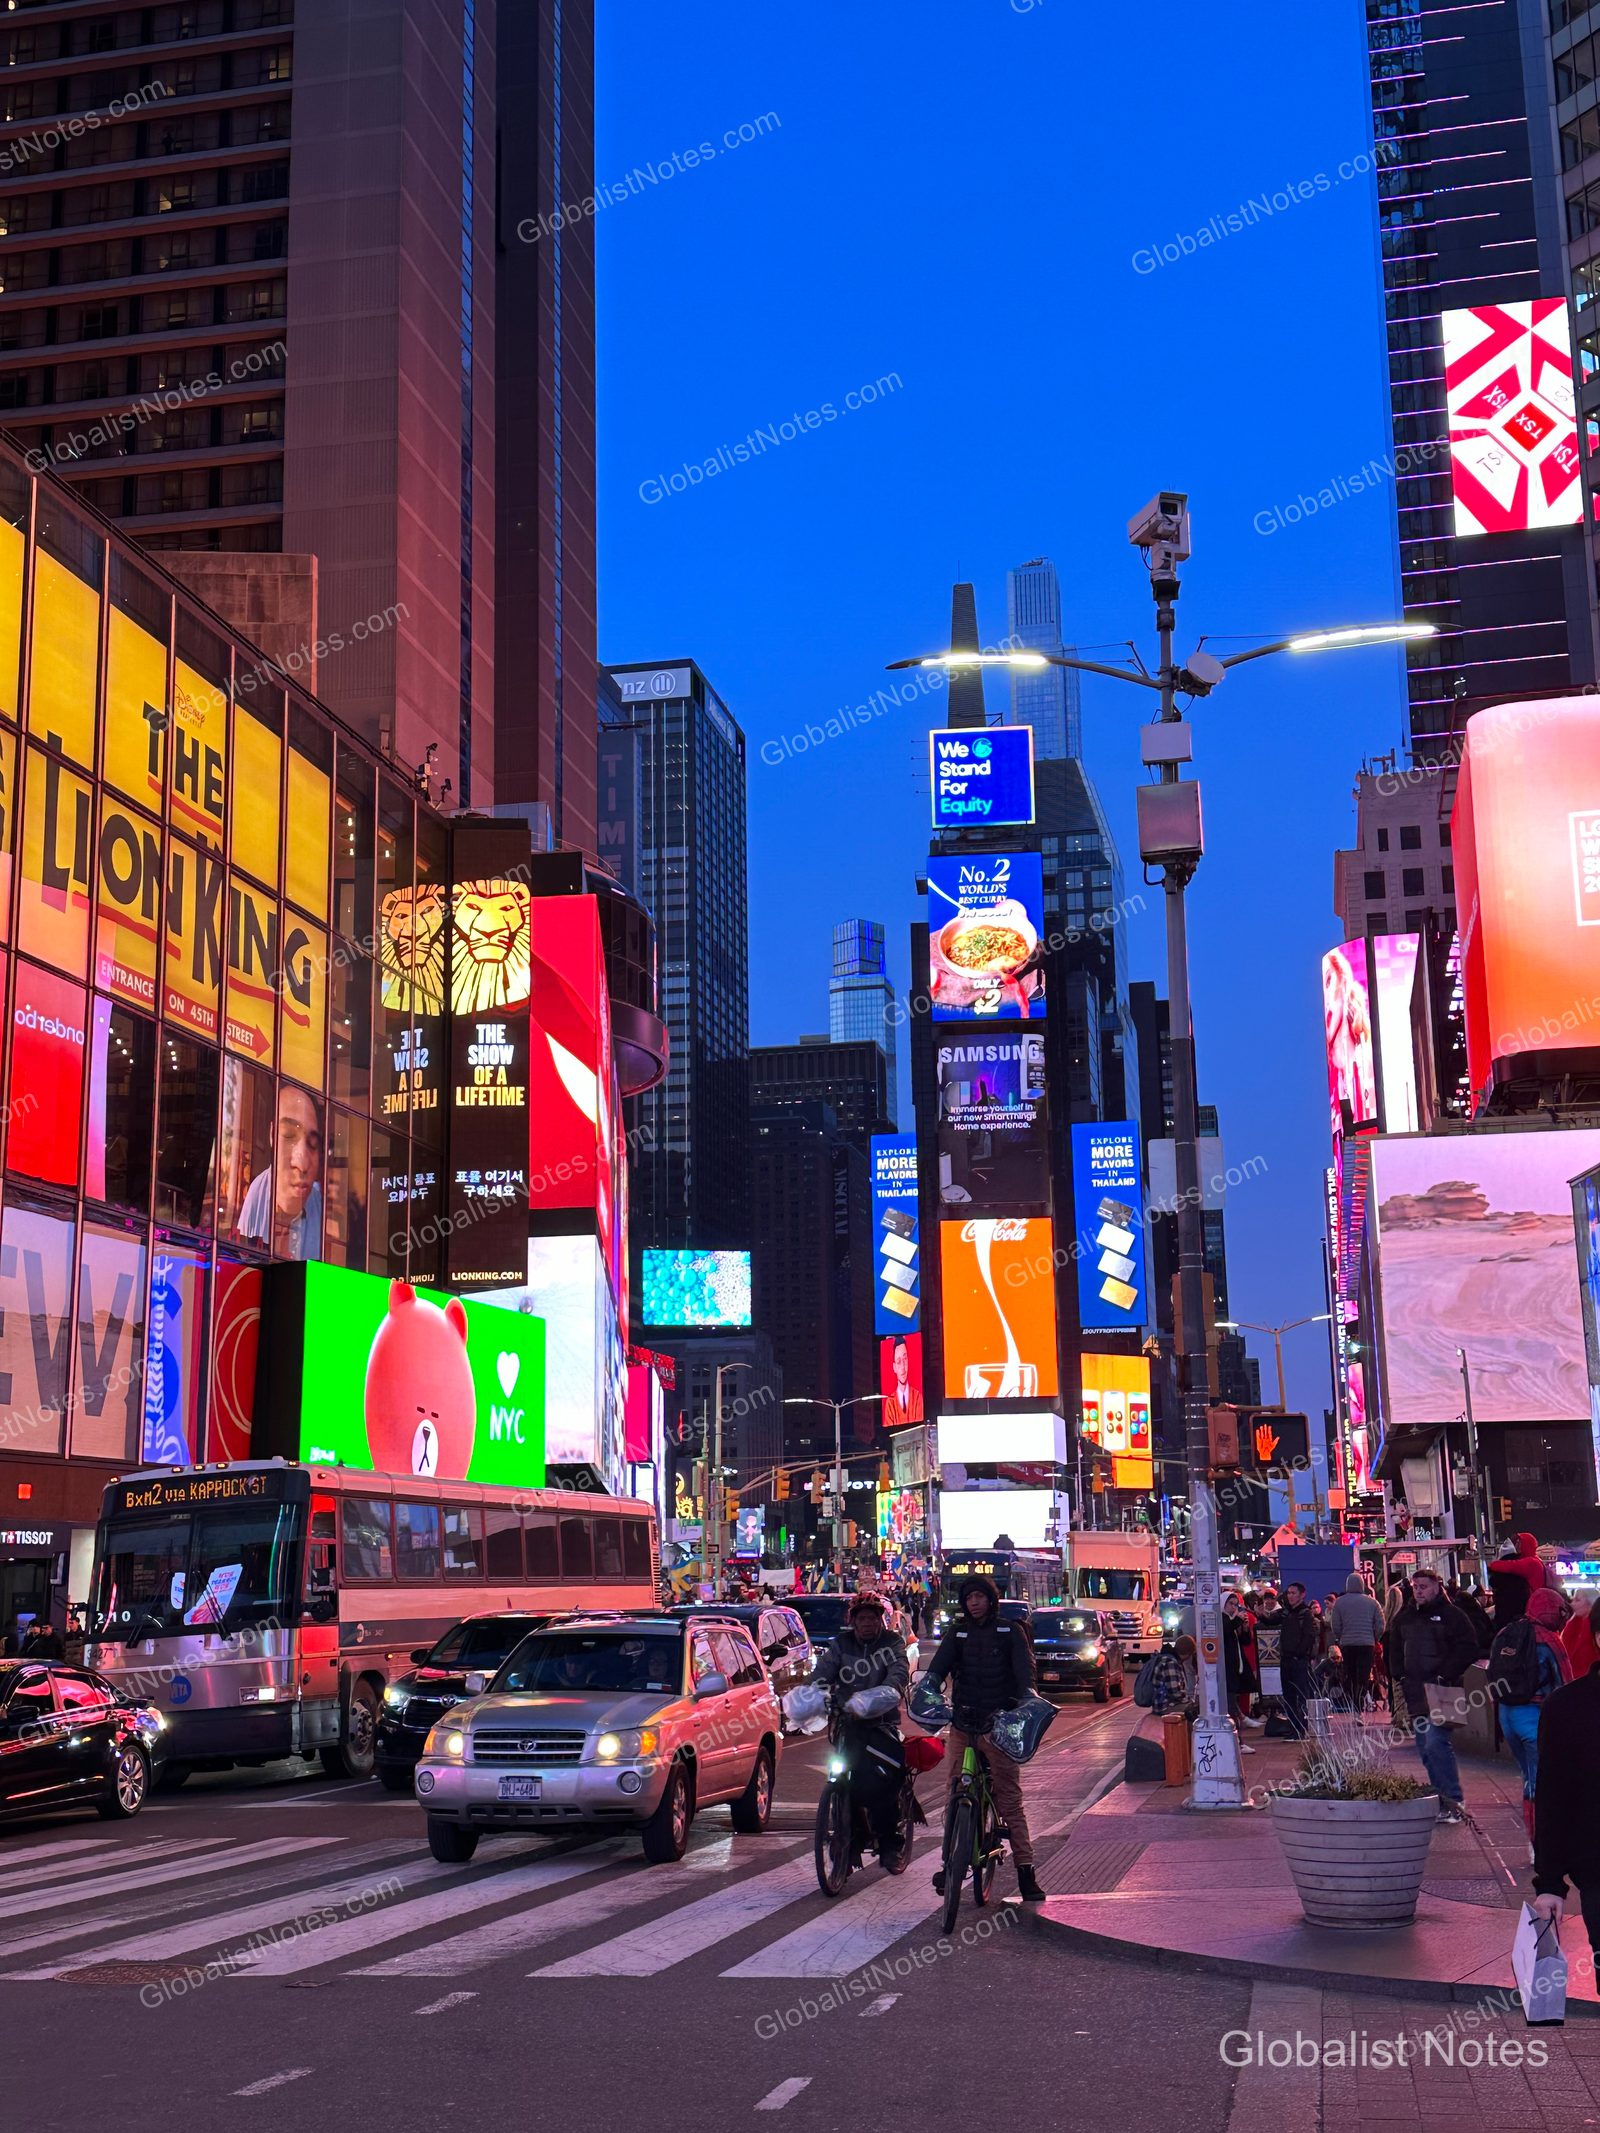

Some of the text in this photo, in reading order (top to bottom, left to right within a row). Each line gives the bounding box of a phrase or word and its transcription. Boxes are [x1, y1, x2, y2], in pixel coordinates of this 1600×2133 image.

[1516, 413, 1543, 440] TSX
[938, 741, 969, 758] We
[142, 701, 224, 820] THE
[939, 760, 991, 777] Stand
[940, 780, 968, 795] For
[940, 797, 993, 816] Equity
[41, 730, 184, 937] LION
[192, 831, 311, 1008] KING
[958, 883, 1008, 895] WORLD'S
[100, 959, 255, 1048] ENTRANCE ON 45TH STREET
[973, 990, 1001, 1015] $2
[476, 1024, 506, 1044] THE
[467, 1045, 514, 1065] SHOW
[941, 1044, 1040, 1064] SAMSUNG
[474, 1066, 507, 1085] OF A
[455, 1087, 525, 1106] LIFETIME
[1090, 1136, 1134, 1144] EXPLORE
[1091, 1145, 1134, 1158] MORE
[876, 1157, 918, 1169] MORE
[1091, 1159, 1135, 1169] FLAVORS
[485, 1169, 524, 1184] 여기서
[1108, 1169, 1118, 1177] IN
[463, 1184, 516, 1197] 구하세요
[1091, 1177, 1136, 1187] THAILAND
[452, 1271, 523, 1281] LIONKING.COM
[489, 1403, 526, 1444] NYC
[126, 1484, 162, 1508] BxM2
[165, 1489, 186, 1503] VIA
[190, 1478, 247, 1500] KAPPOCK
[15, 1531, 54, 1545] TISSOT
